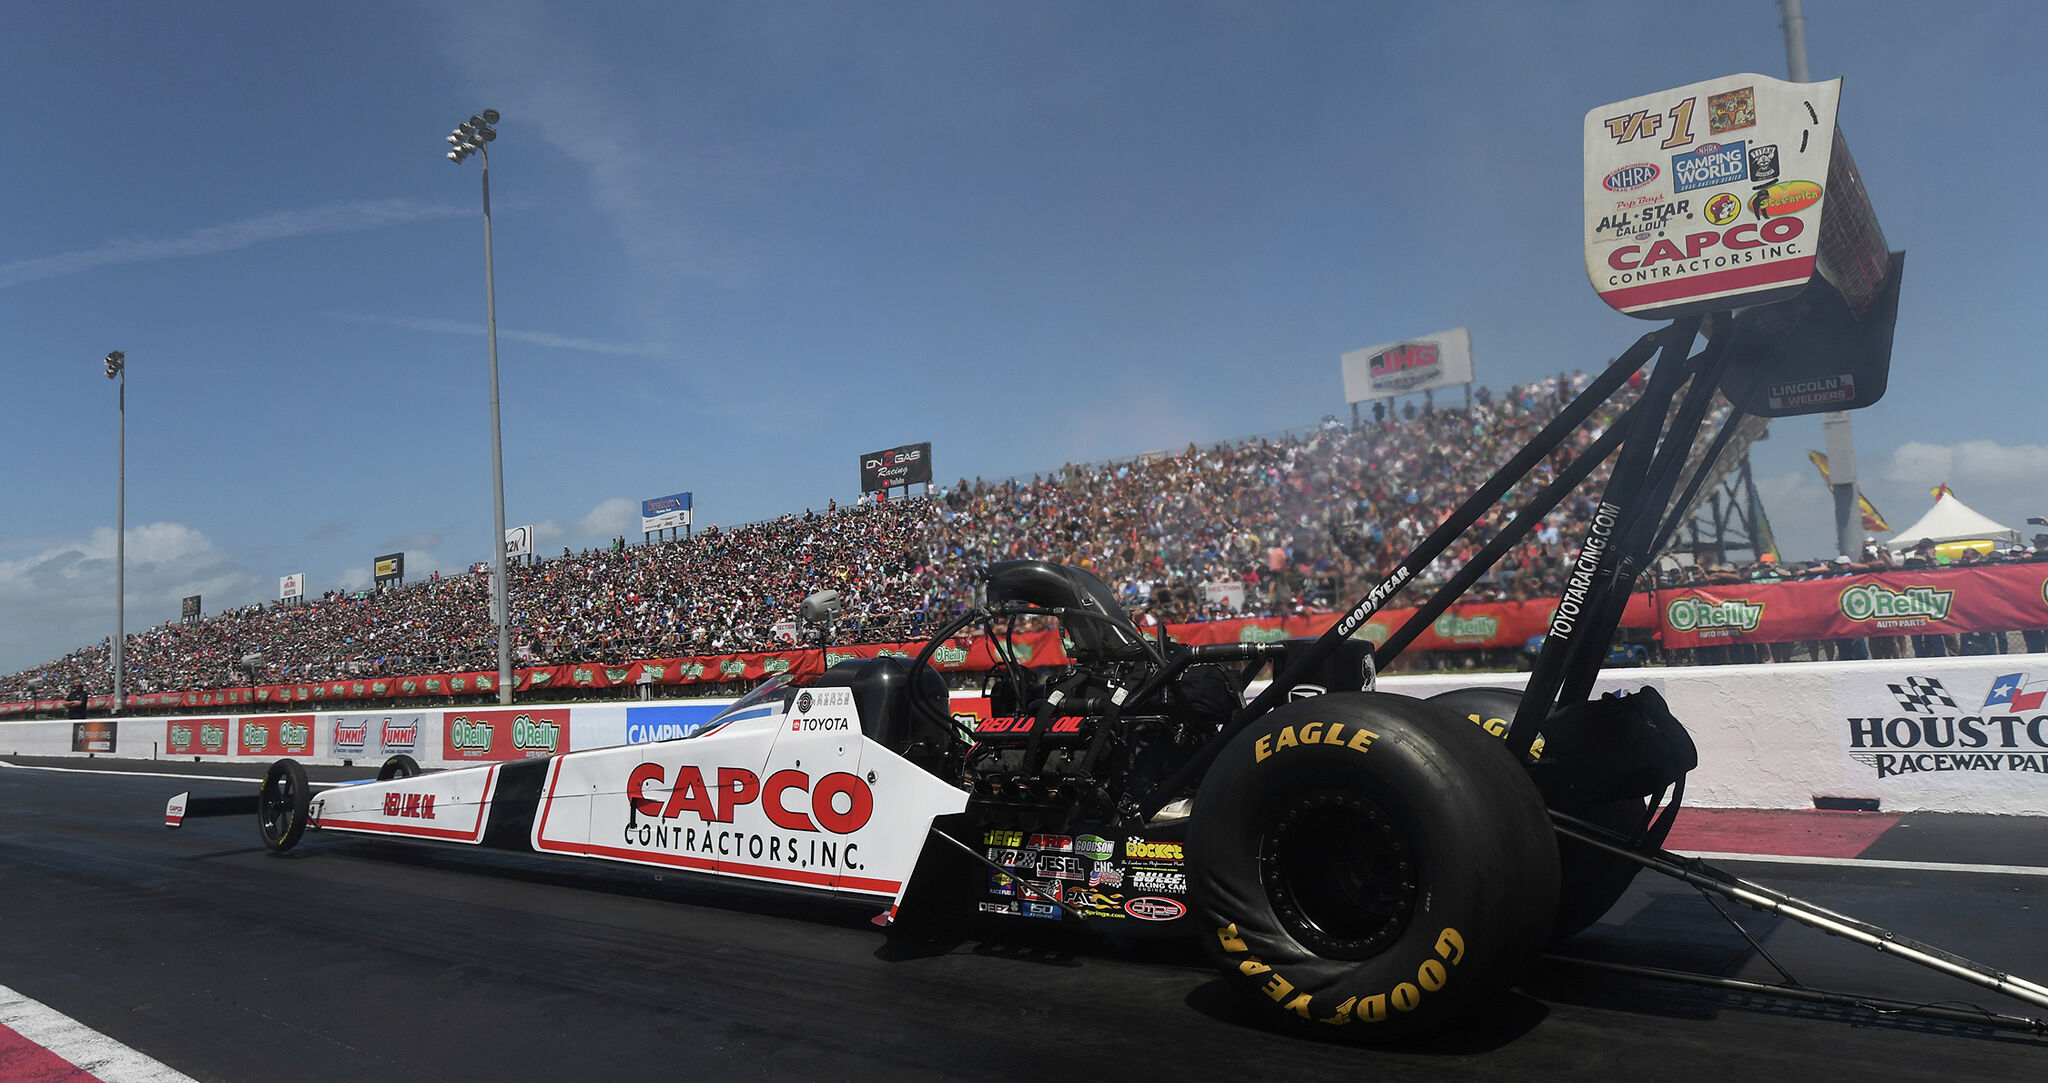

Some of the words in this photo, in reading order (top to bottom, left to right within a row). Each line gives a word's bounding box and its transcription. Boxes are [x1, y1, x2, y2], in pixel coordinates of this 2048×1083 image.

[1604, 109, 1662, 145] T/F
[1660, 97, 1697, 150] 1
[1676, 149, 1742, 172] CAMPING
[1611, 167, 1652, 188] NHRA
[1677, 161, 1743, 185] WORLD
[1616, 219, 1668, 237] CALLOUT
[1607, 216, 1805, 271] CAPCO
[1608, 251, 1753, 286] CONTRACTORS
[1761, 243, 1802, 259] INC.
[1771, 378, 1838, 397] LINCOLN
[1787, 390, 1847, 406] WELDERS
[878, 467, 908, 478] Racing
[1550, 501, 1621, 640] TOYOTARACING.COM
[1337, 566, 1410, 636] GOODYEAR
[1843, 587, 1950, 618] O'Reilly
[1669, 599, 1761, 630] O'Reilly
[1899, 619, 1926, 627] PARTS
[935, 646, 966, 662] O'Reilly
[452, 718, 493, 751] O'Reilly
[512, 716, 559, 753] O'Reilly
[802, 717, 849, 731] TOYOTA
[975, 717, 1014, 732] RED
[1051, 716, 1084, 732] OIL
[1847, 716, 2048, 748] HOUSTO
[1254, 721, 1380, 764] EAGLE
[1876, 754, 2004, 779] RACEWAY
[2007, 754, 2048, 774] PA
[384, 792, 401, 816] RED
[627, 763, 874, 835] CAPCO
[984, 830, 1023, 847] JEGS
[1028, 834, 1071, 849] ARP
[1075, 840, 1114, 853] GOODSON
[1038, 856, 1083, 873] JESEL
[1093, 861, 1114, 873] CNC
[1217, 923, 1465, 1025] GOODYEAR
